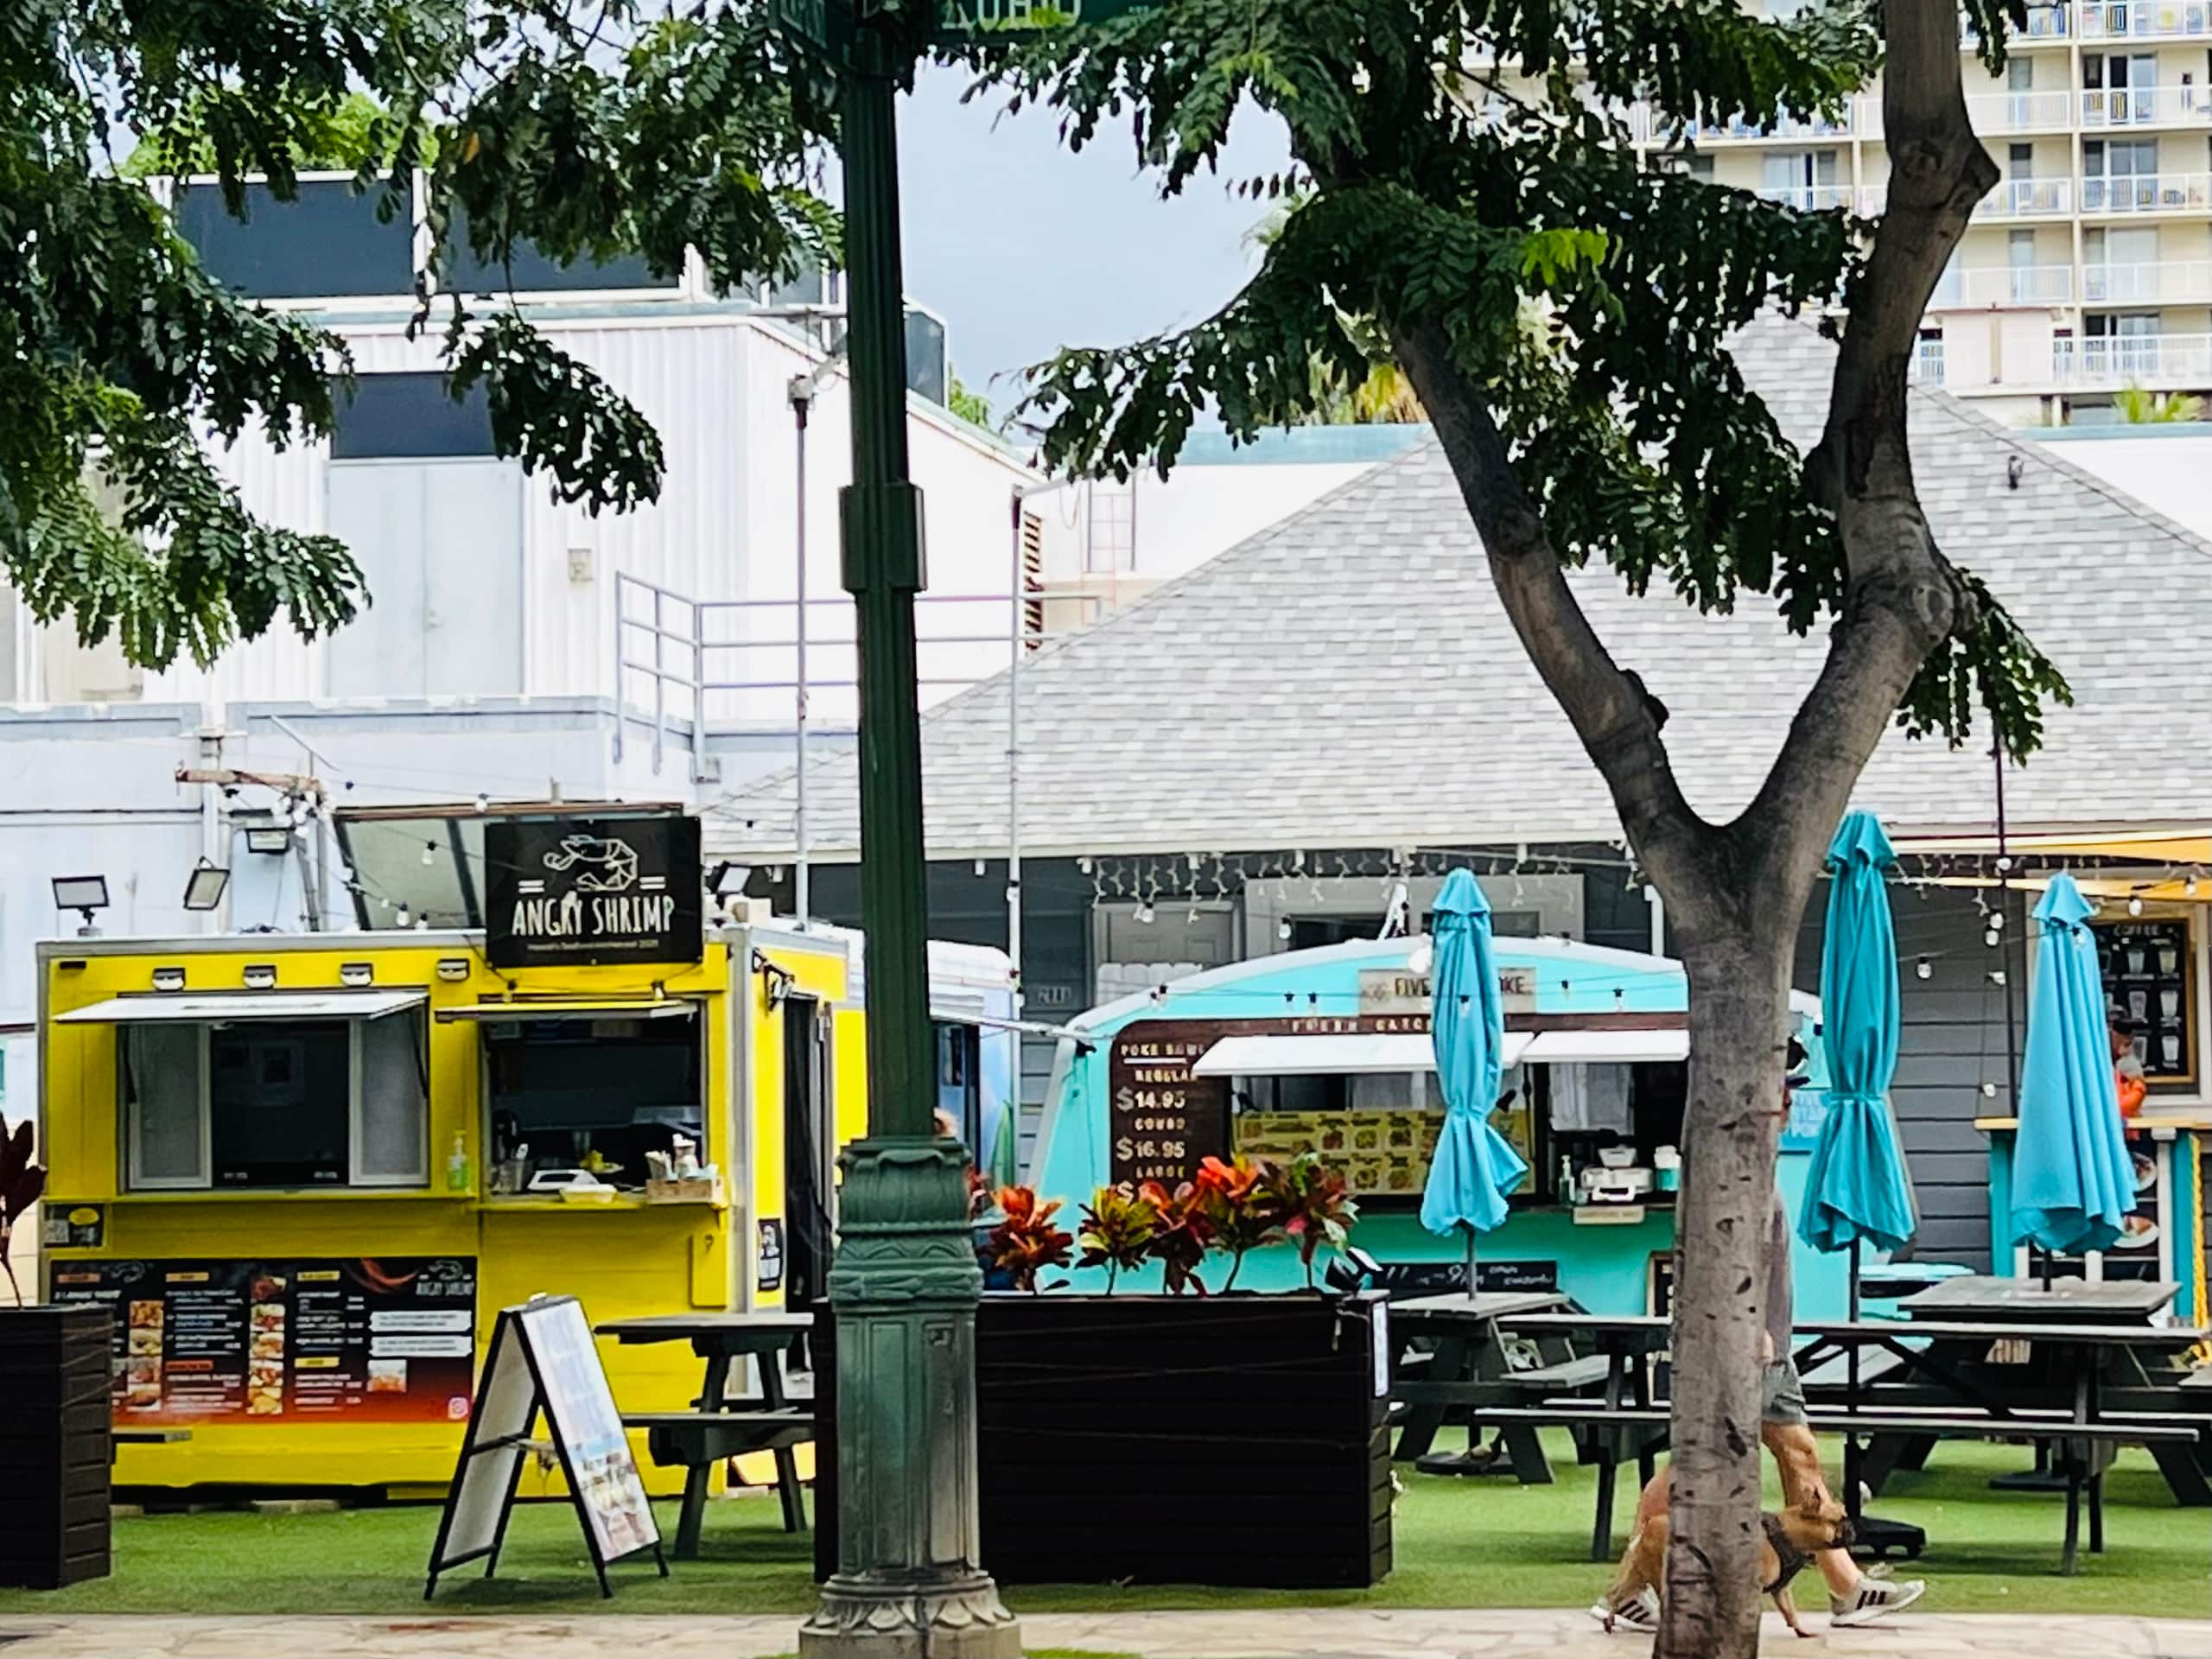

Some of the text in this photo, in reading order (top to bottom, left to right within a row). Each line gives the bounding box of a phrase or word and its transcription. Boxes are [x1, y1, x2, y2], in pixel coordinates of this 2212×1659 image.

[512, 893, 676, 936] ANGRY SHRIMP
[1395, 976, 1432, 996] FIVE
[1121, 1044, 1159, 1056] POKE
[1116, 1085, 1185, 1112] $14.95
[1116, 1136, 1185, 1161] $16.95
[1136, 1165, 1185, 1179] LARGE
